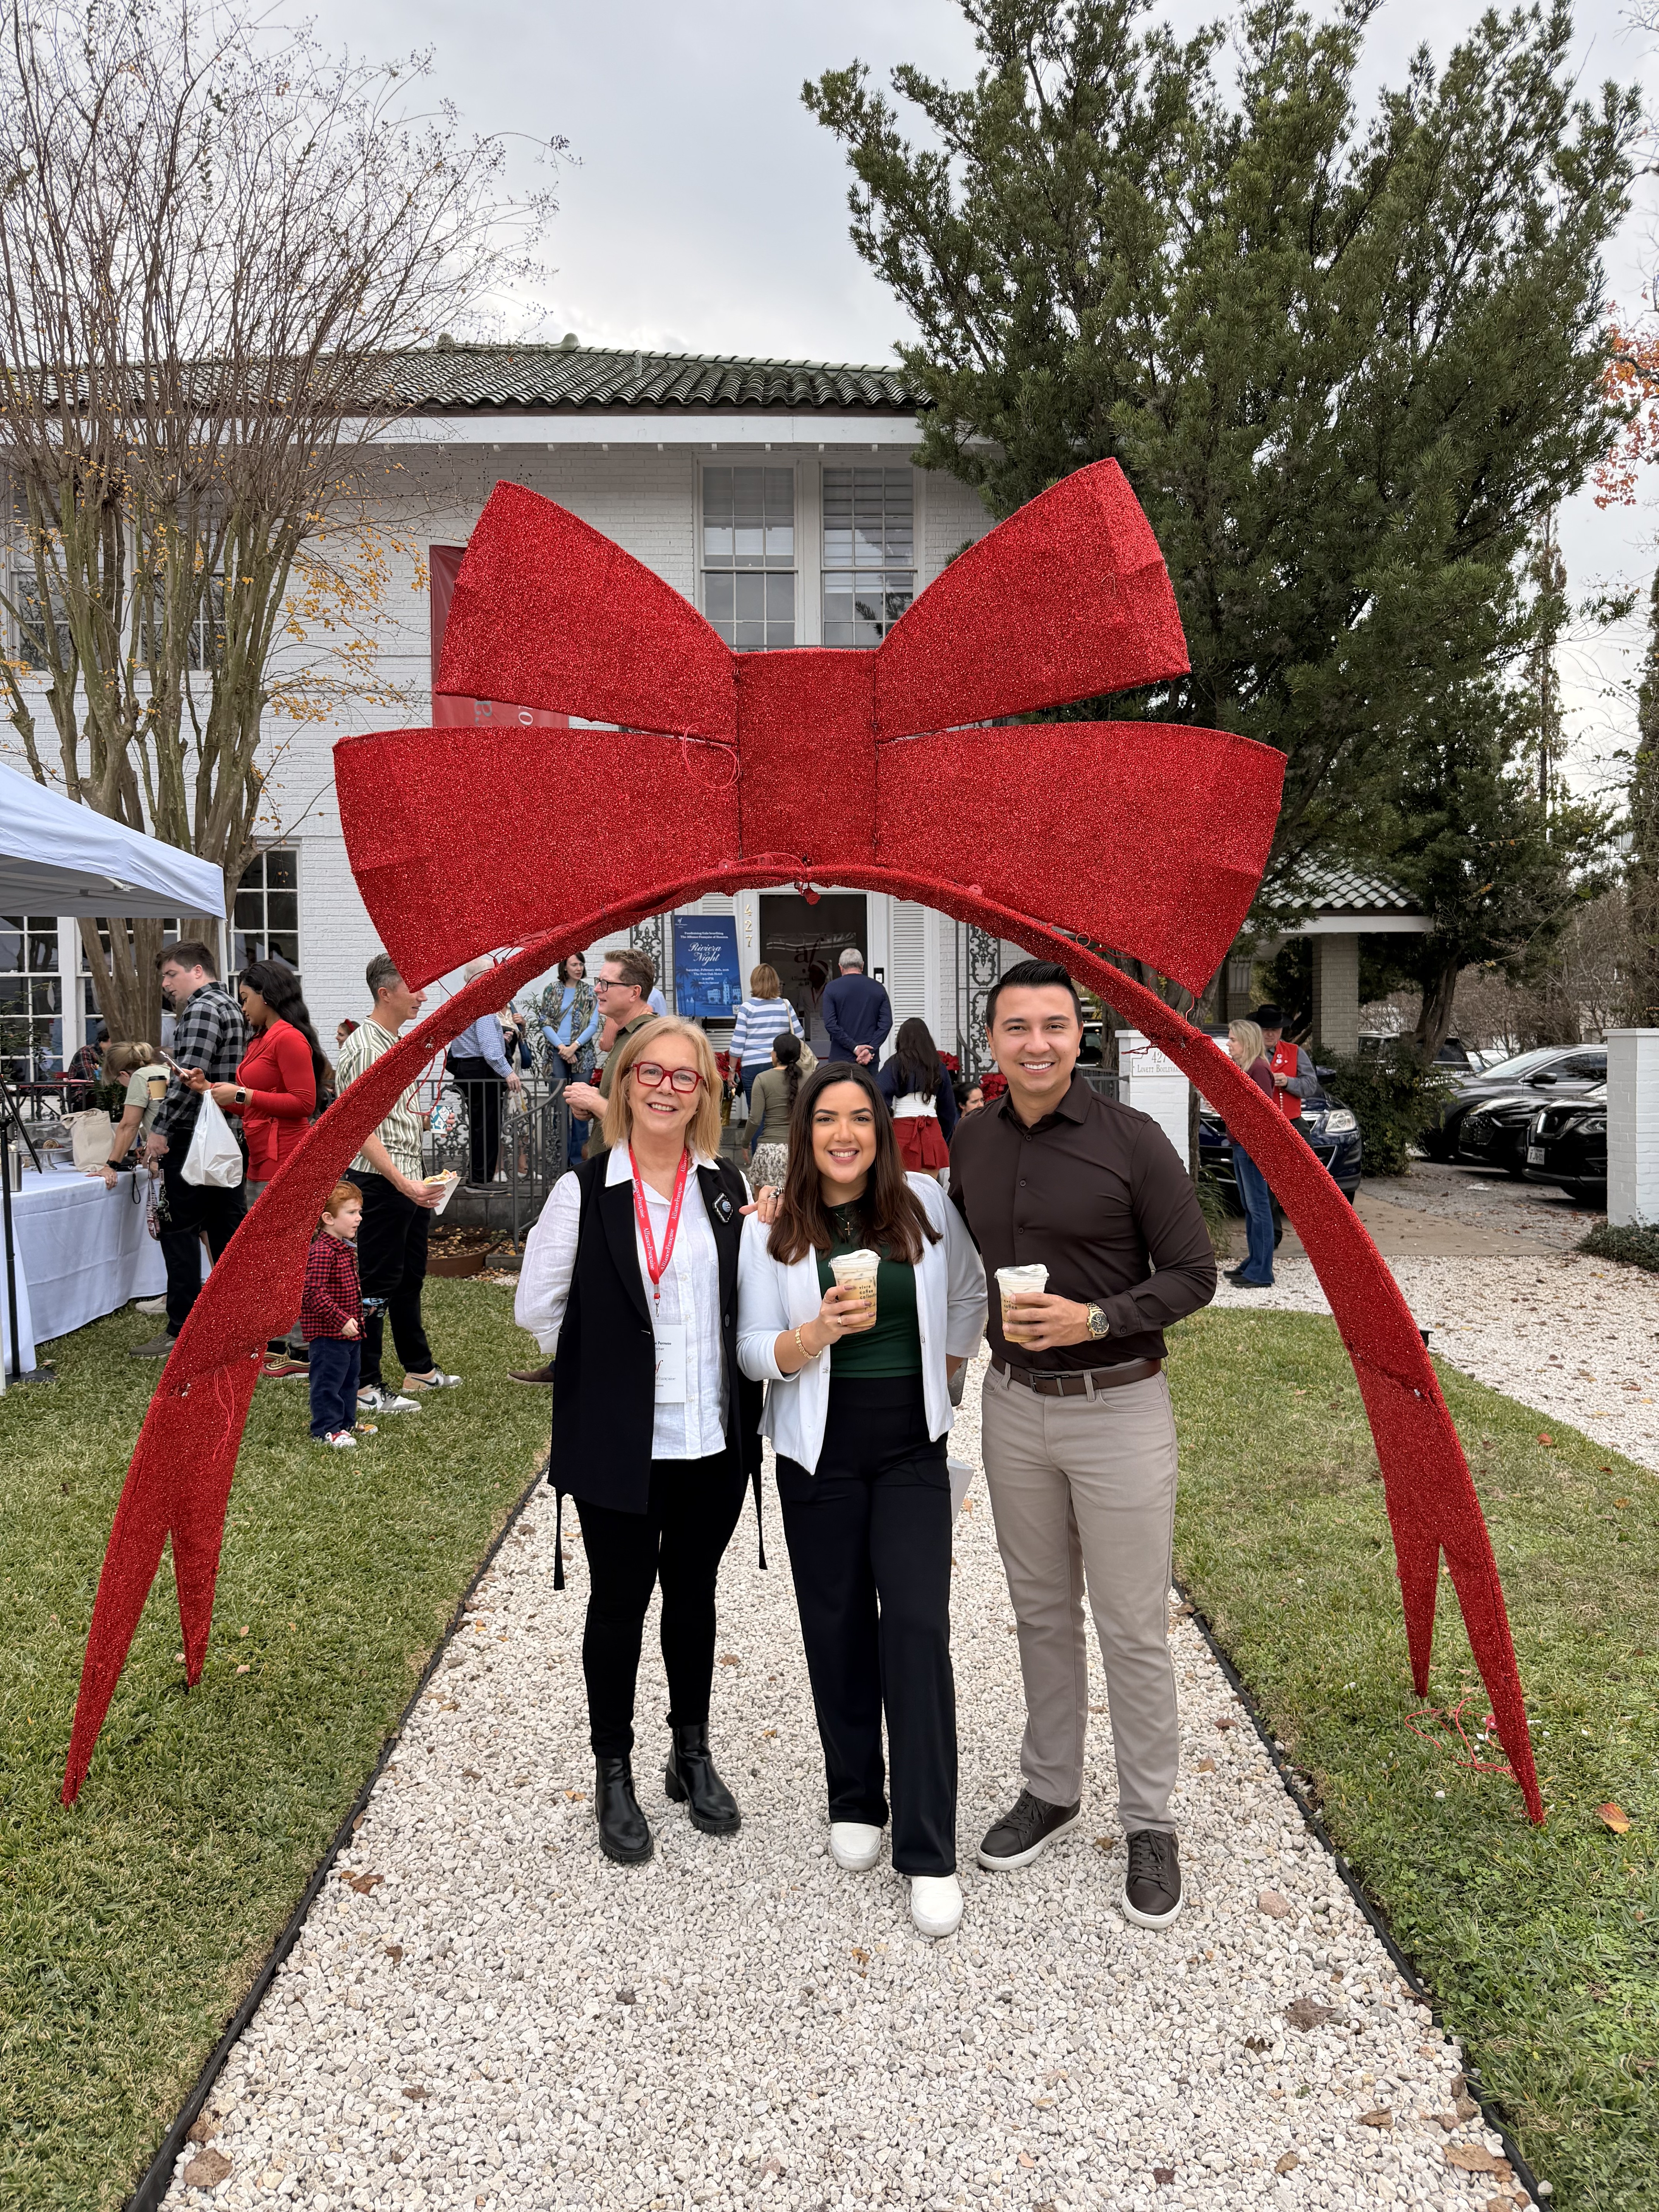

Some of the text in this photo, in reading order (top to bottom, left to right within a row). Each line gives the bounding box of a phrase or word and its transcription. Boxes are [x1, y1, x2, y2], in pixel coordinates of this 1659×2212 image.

[688, 942, 722, 951] Riviera
[693, 951, 720, 966] Night
[643, 1227, 655, 1270] AllianceFrançaise
[661, 1228, 674, 1271] AllianceFrançaise
